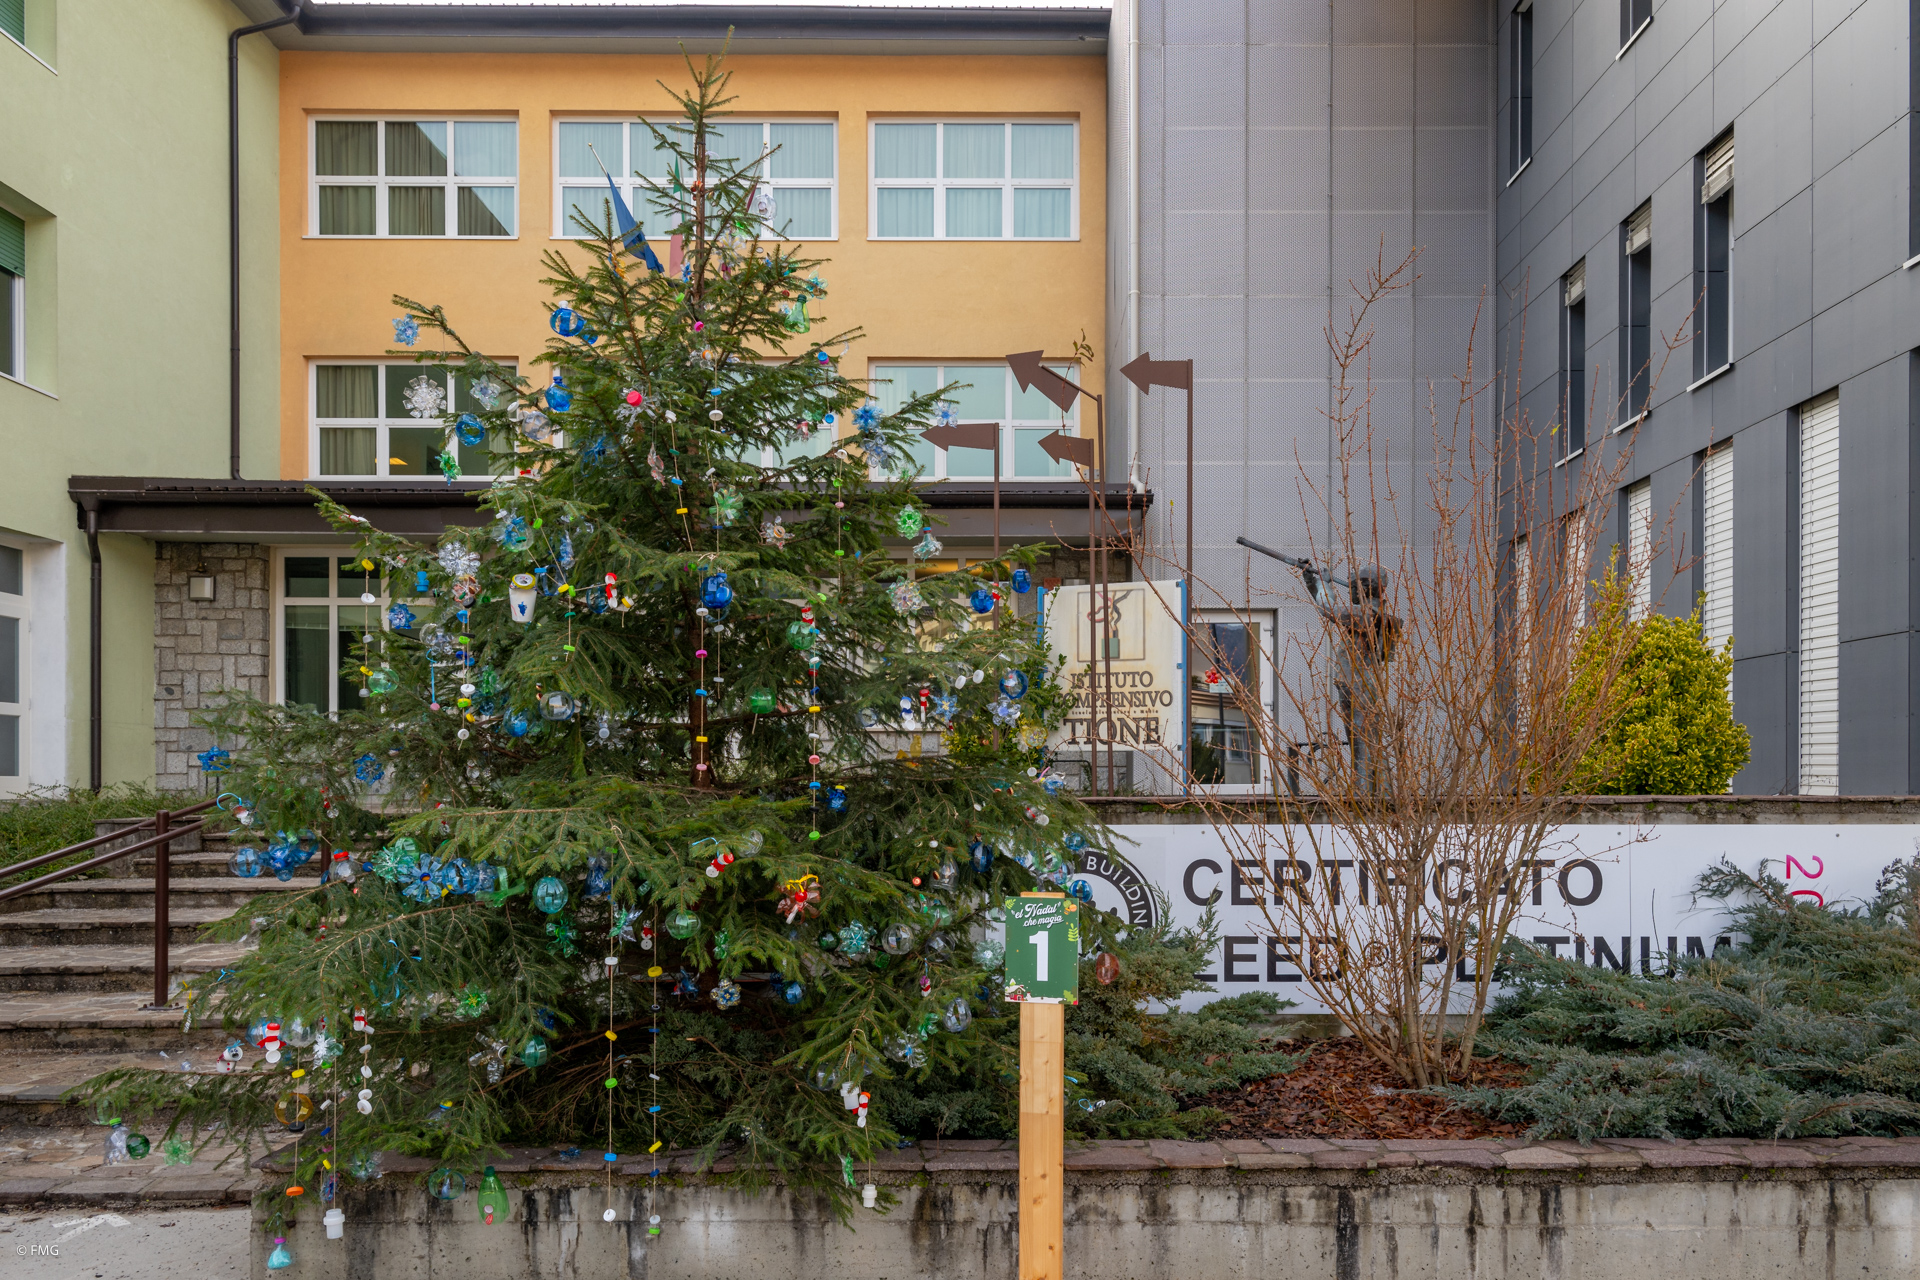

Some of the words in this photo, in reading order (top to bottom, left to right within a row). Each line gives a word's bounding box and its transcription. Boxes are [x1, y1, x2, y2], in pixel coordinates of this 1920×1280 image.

[1063, 717, 1161, 745] TIONE
[1023, 917, 1037, 927] che
[1029, 931, 1048, 981] 1
[1193, 936, 1349, 982] EED
[1414, 936, 1731, 982] PLTINU
